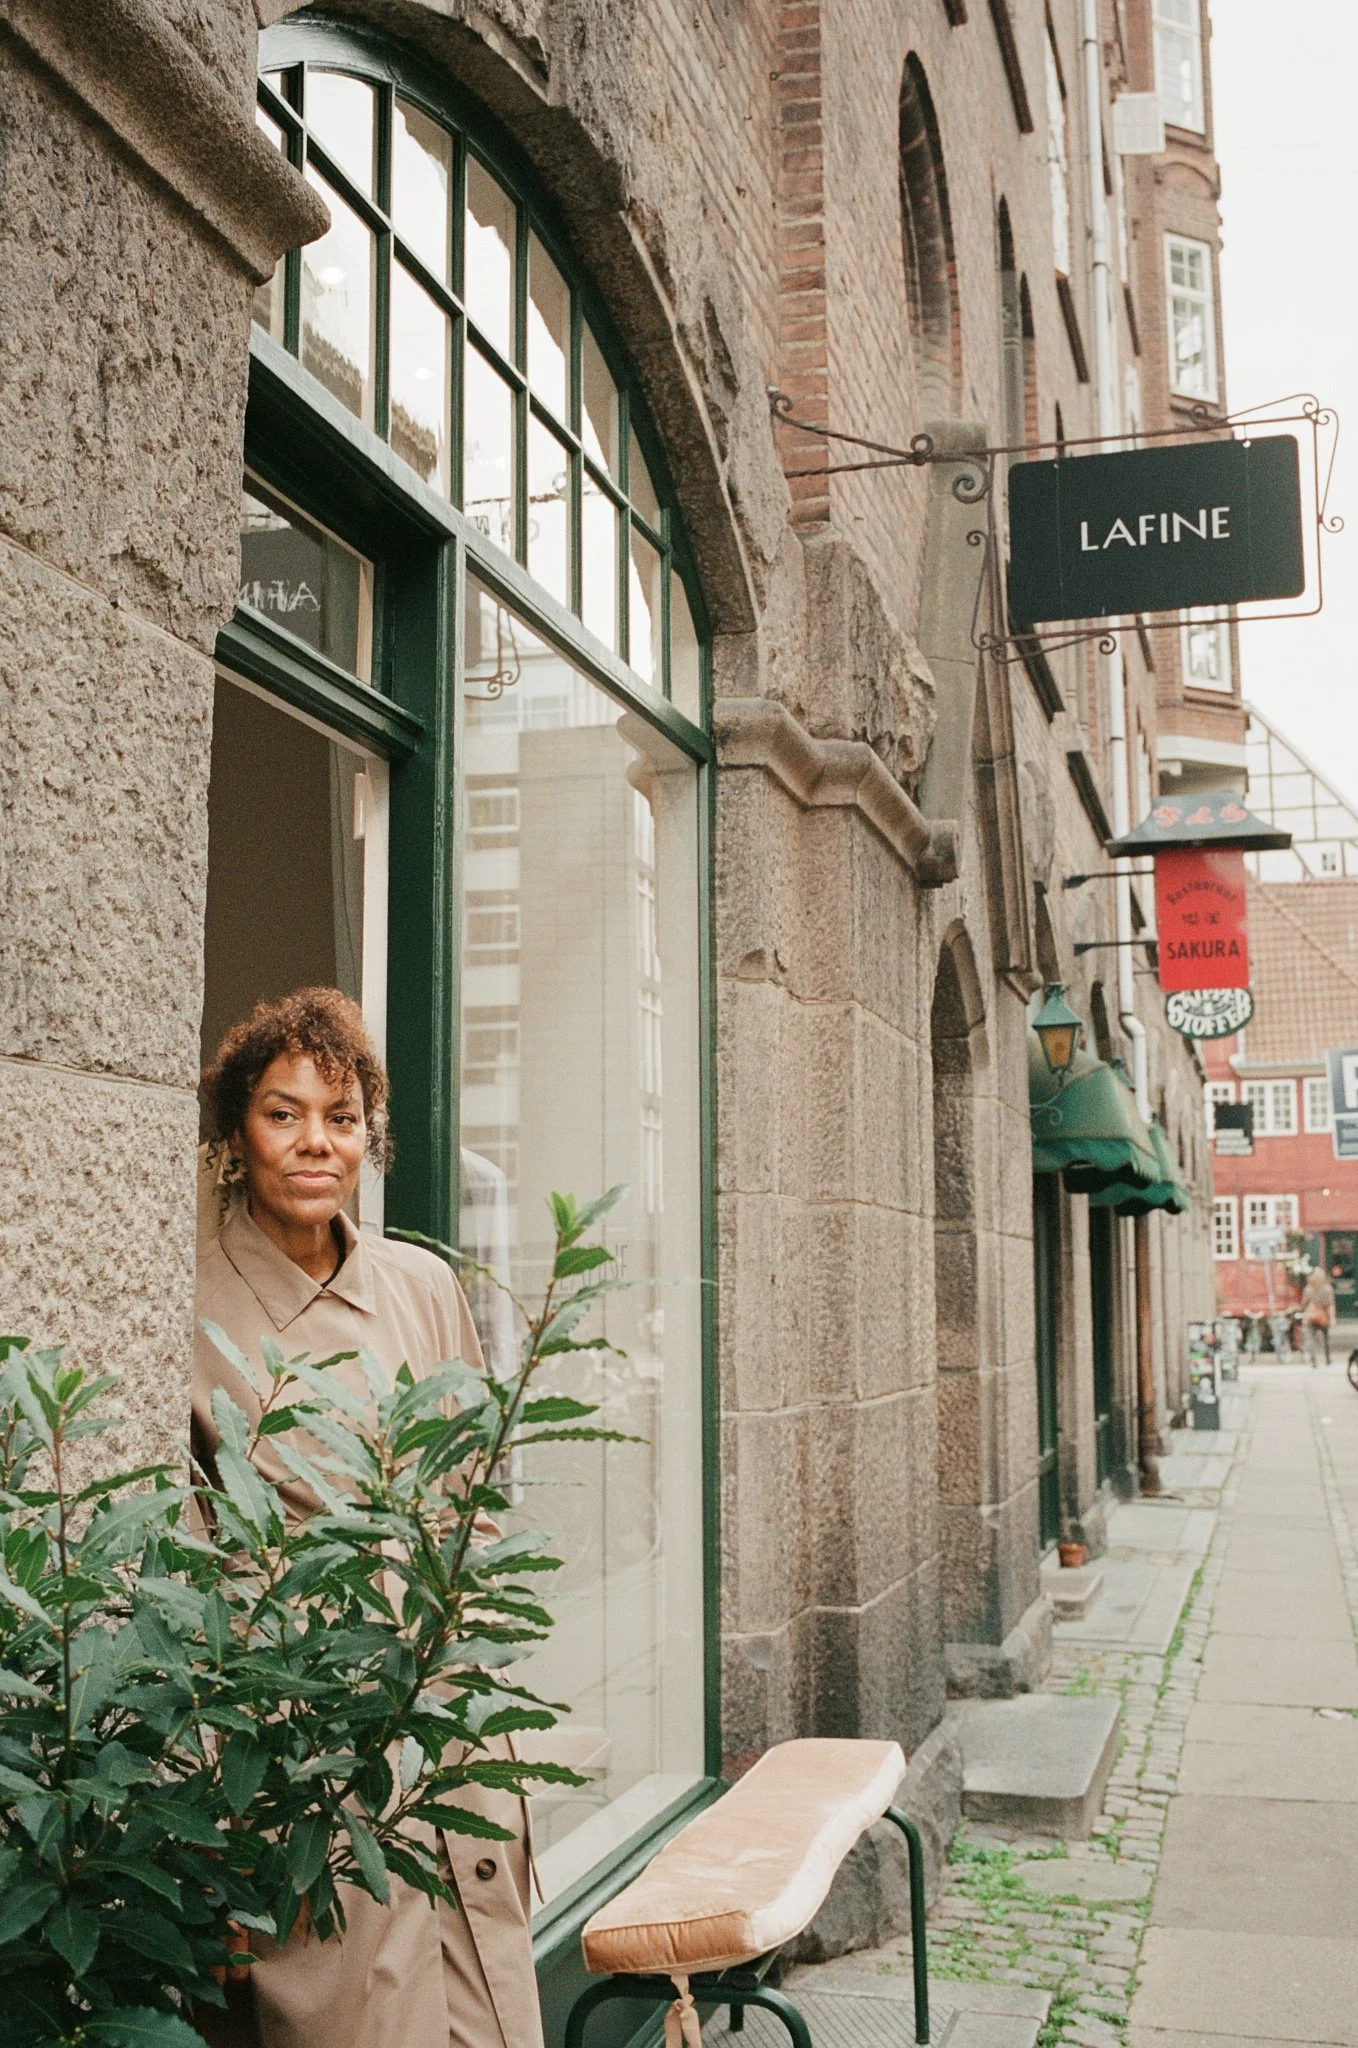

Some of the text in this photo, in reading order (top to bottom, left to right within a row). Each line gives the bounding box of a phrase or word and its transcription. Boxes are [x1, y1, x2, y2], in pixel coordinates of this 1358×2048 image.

[1081, 507, 1230, 551] LAFINE
[1167, 939, 1240, 960] SAKURA
[1167, 1006, 1251, 1036] STOFFER
